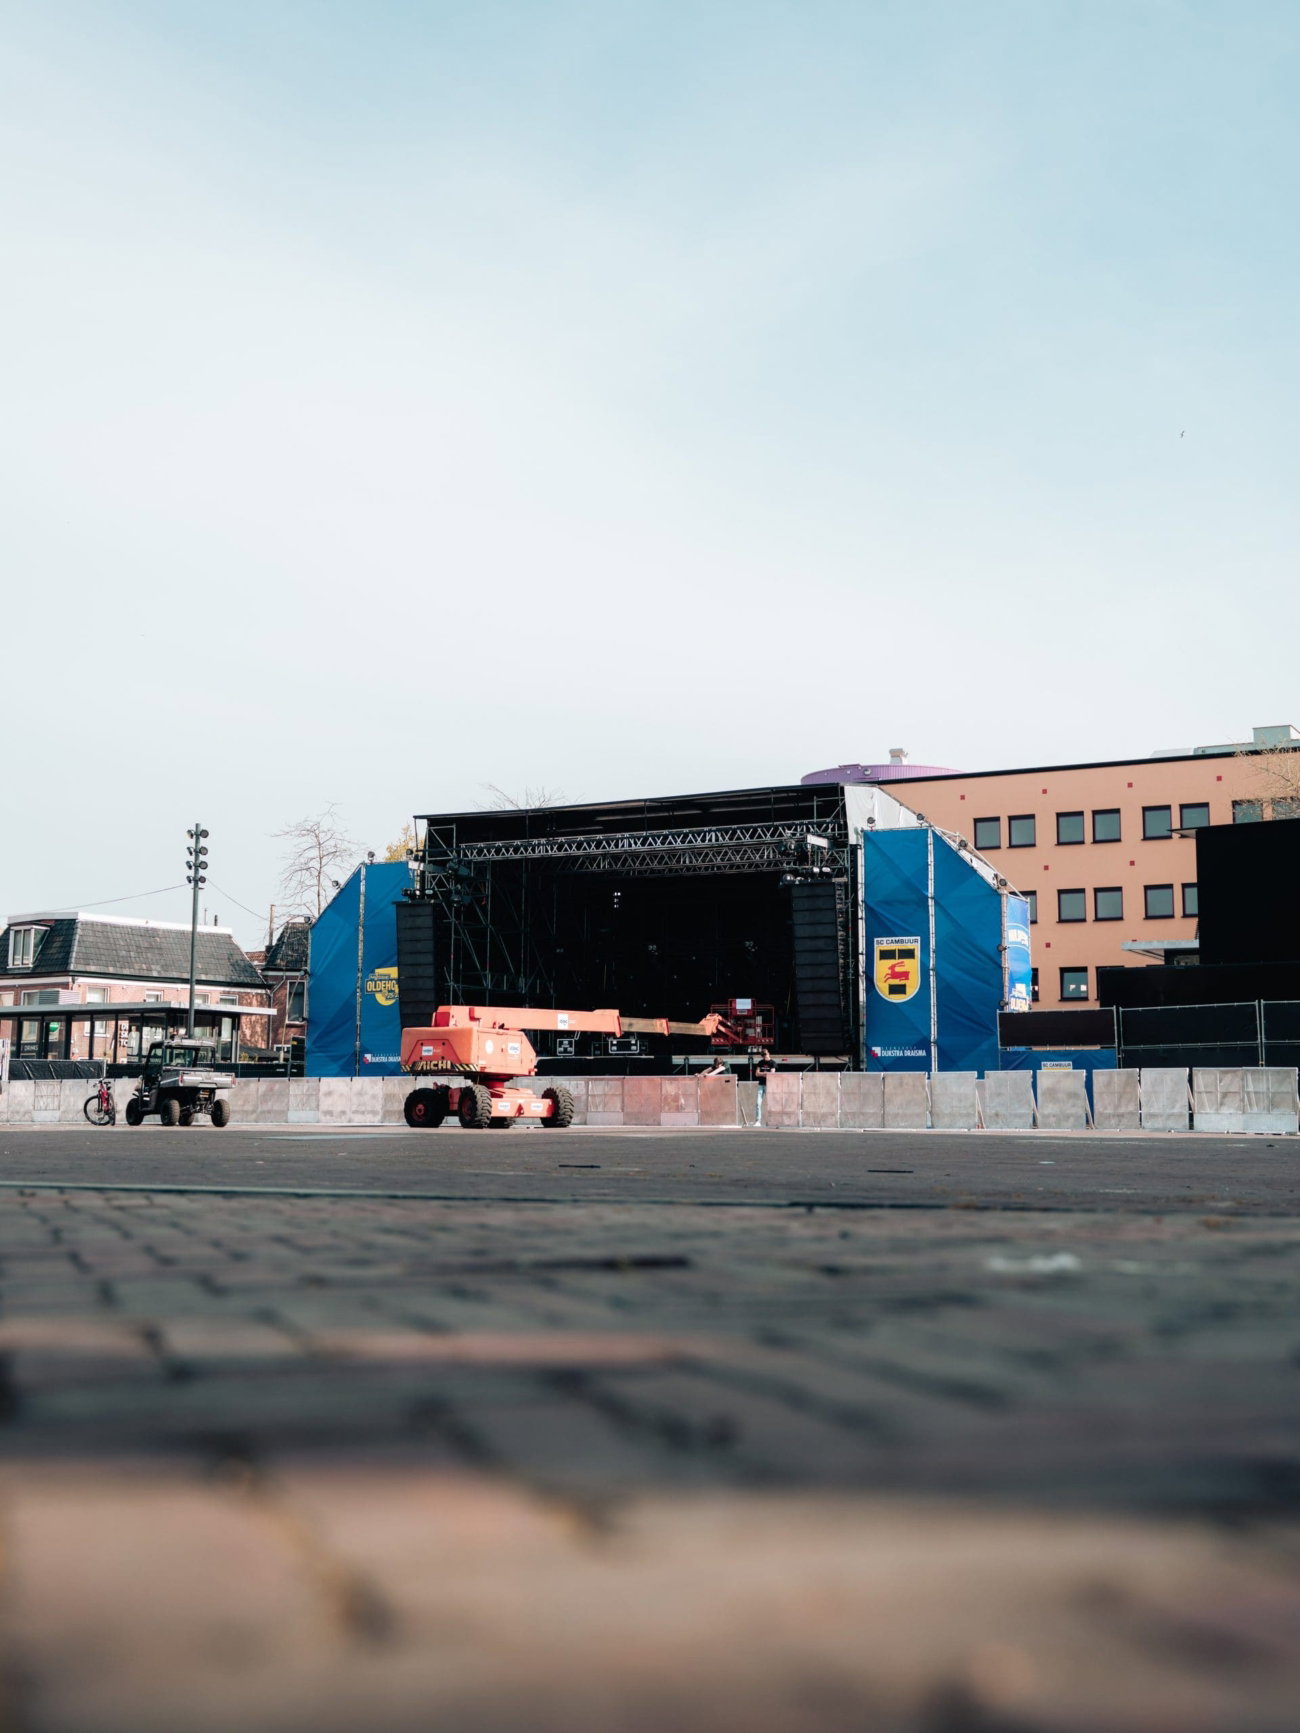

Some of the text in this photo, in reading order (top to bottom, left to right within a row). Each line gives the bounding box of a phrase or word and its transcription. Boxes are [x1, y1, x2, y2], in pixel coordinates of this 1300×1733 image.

[366, 980, 397, 992] OLDEHO
[904, 1049, 927, 1057] DRAISMA
[418, 1060, 452, 1071] AICHI
